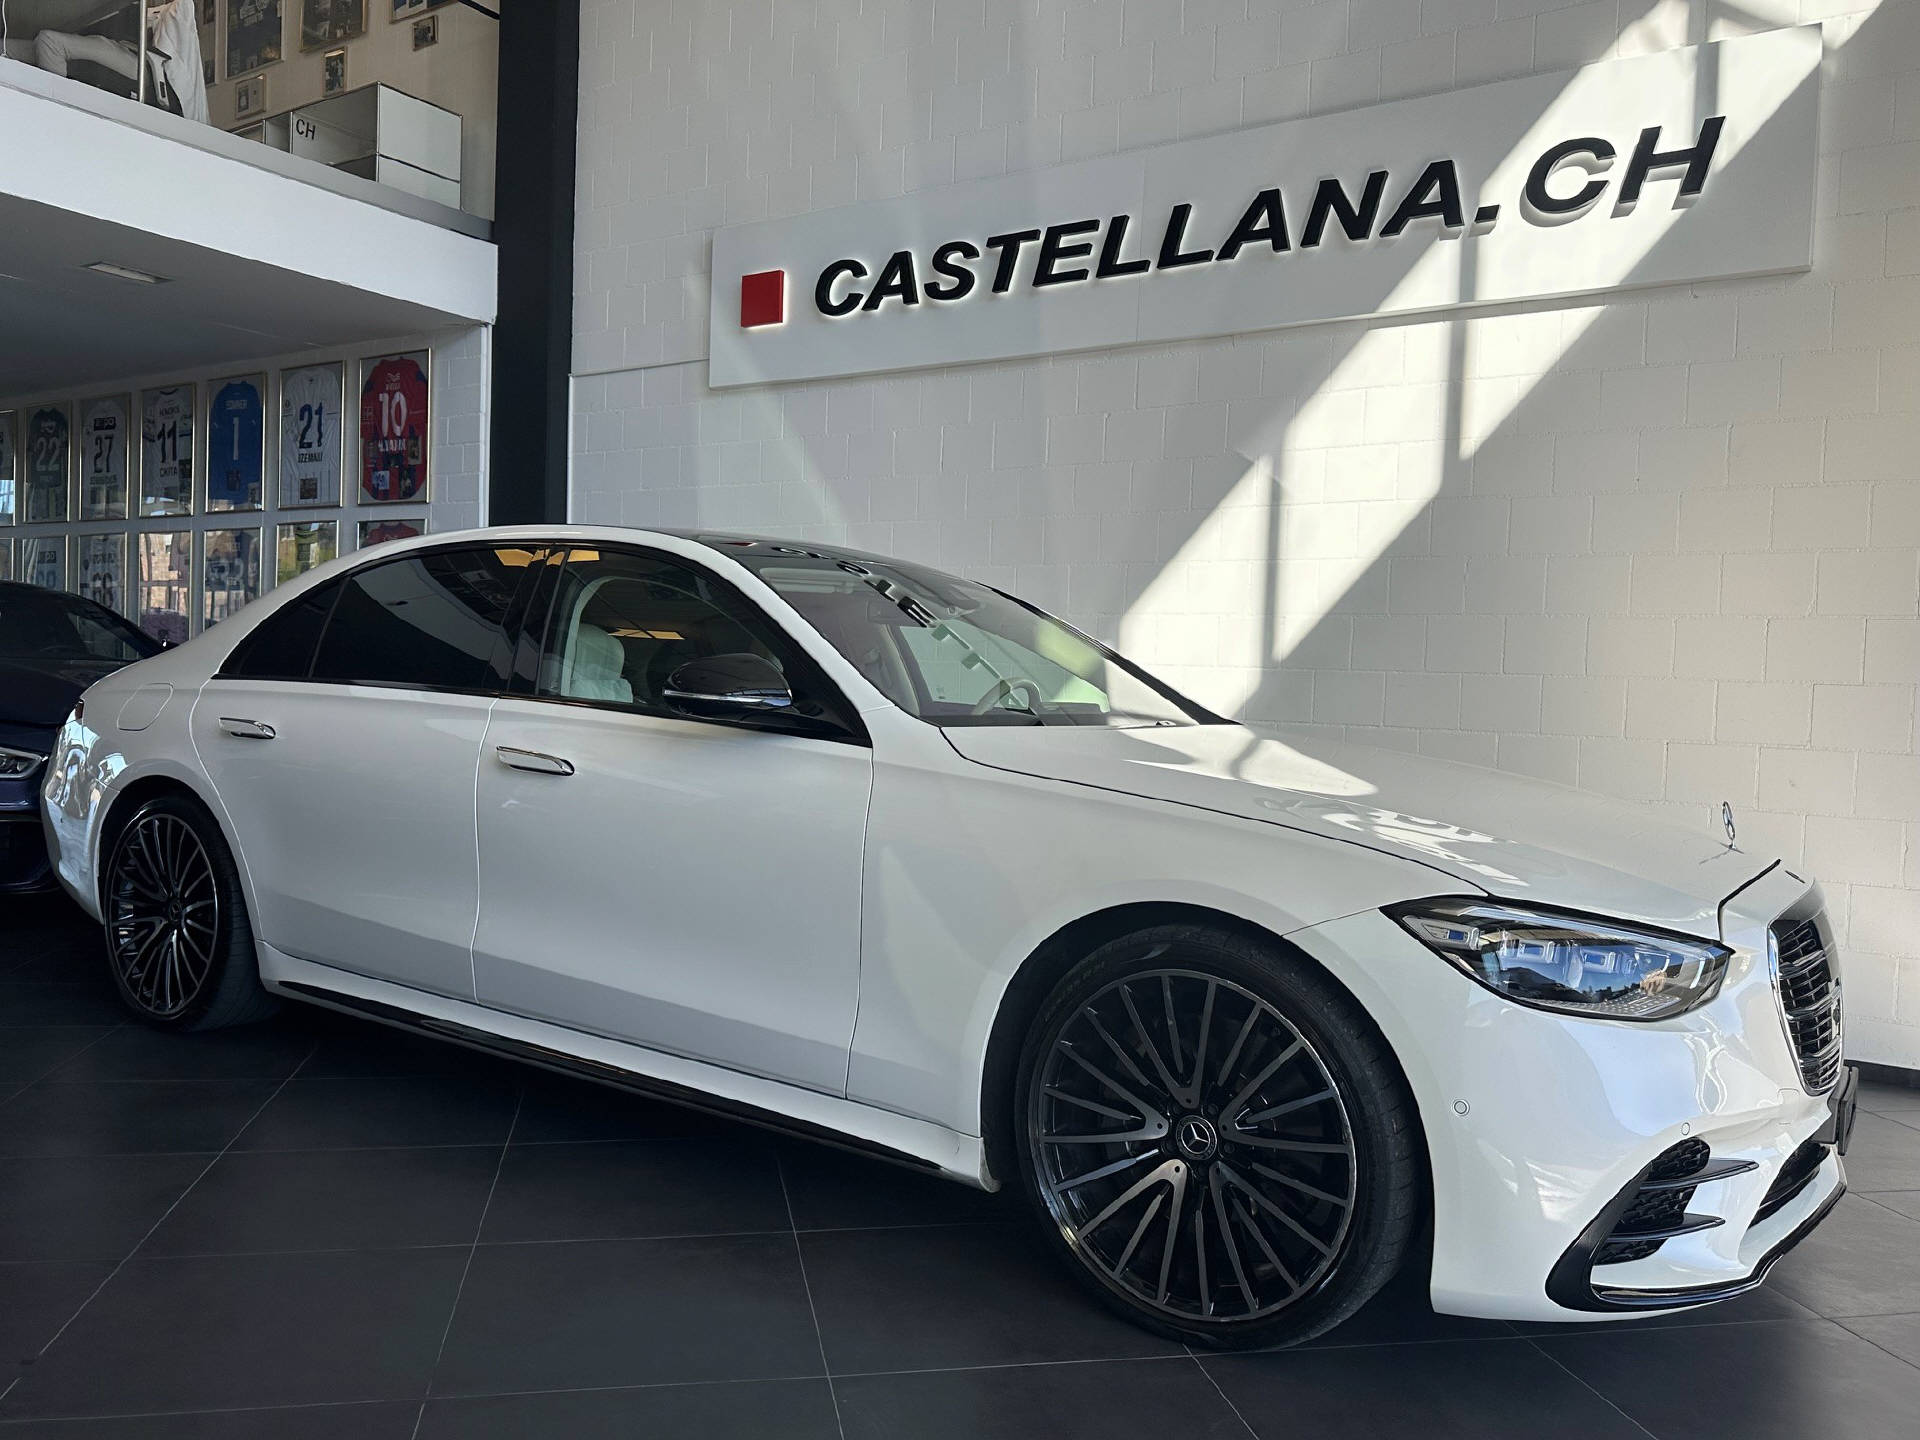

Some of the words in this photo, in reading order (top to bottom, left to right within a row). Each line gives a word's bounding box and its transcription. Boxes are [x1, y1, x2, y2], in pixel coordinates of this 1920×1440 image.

[296, 118, 316, 140] CH
[814, 115, 1726, 318] CASTELLANA.CH
[299, 402, 323, 449] 21
[378, 391, 408, 437] 10
[35, 436, 61, 472] 22
[94, 434, 114, 473] 27
[157, 420, 177, 463] 11
[232, 416, 240, 461] 1
